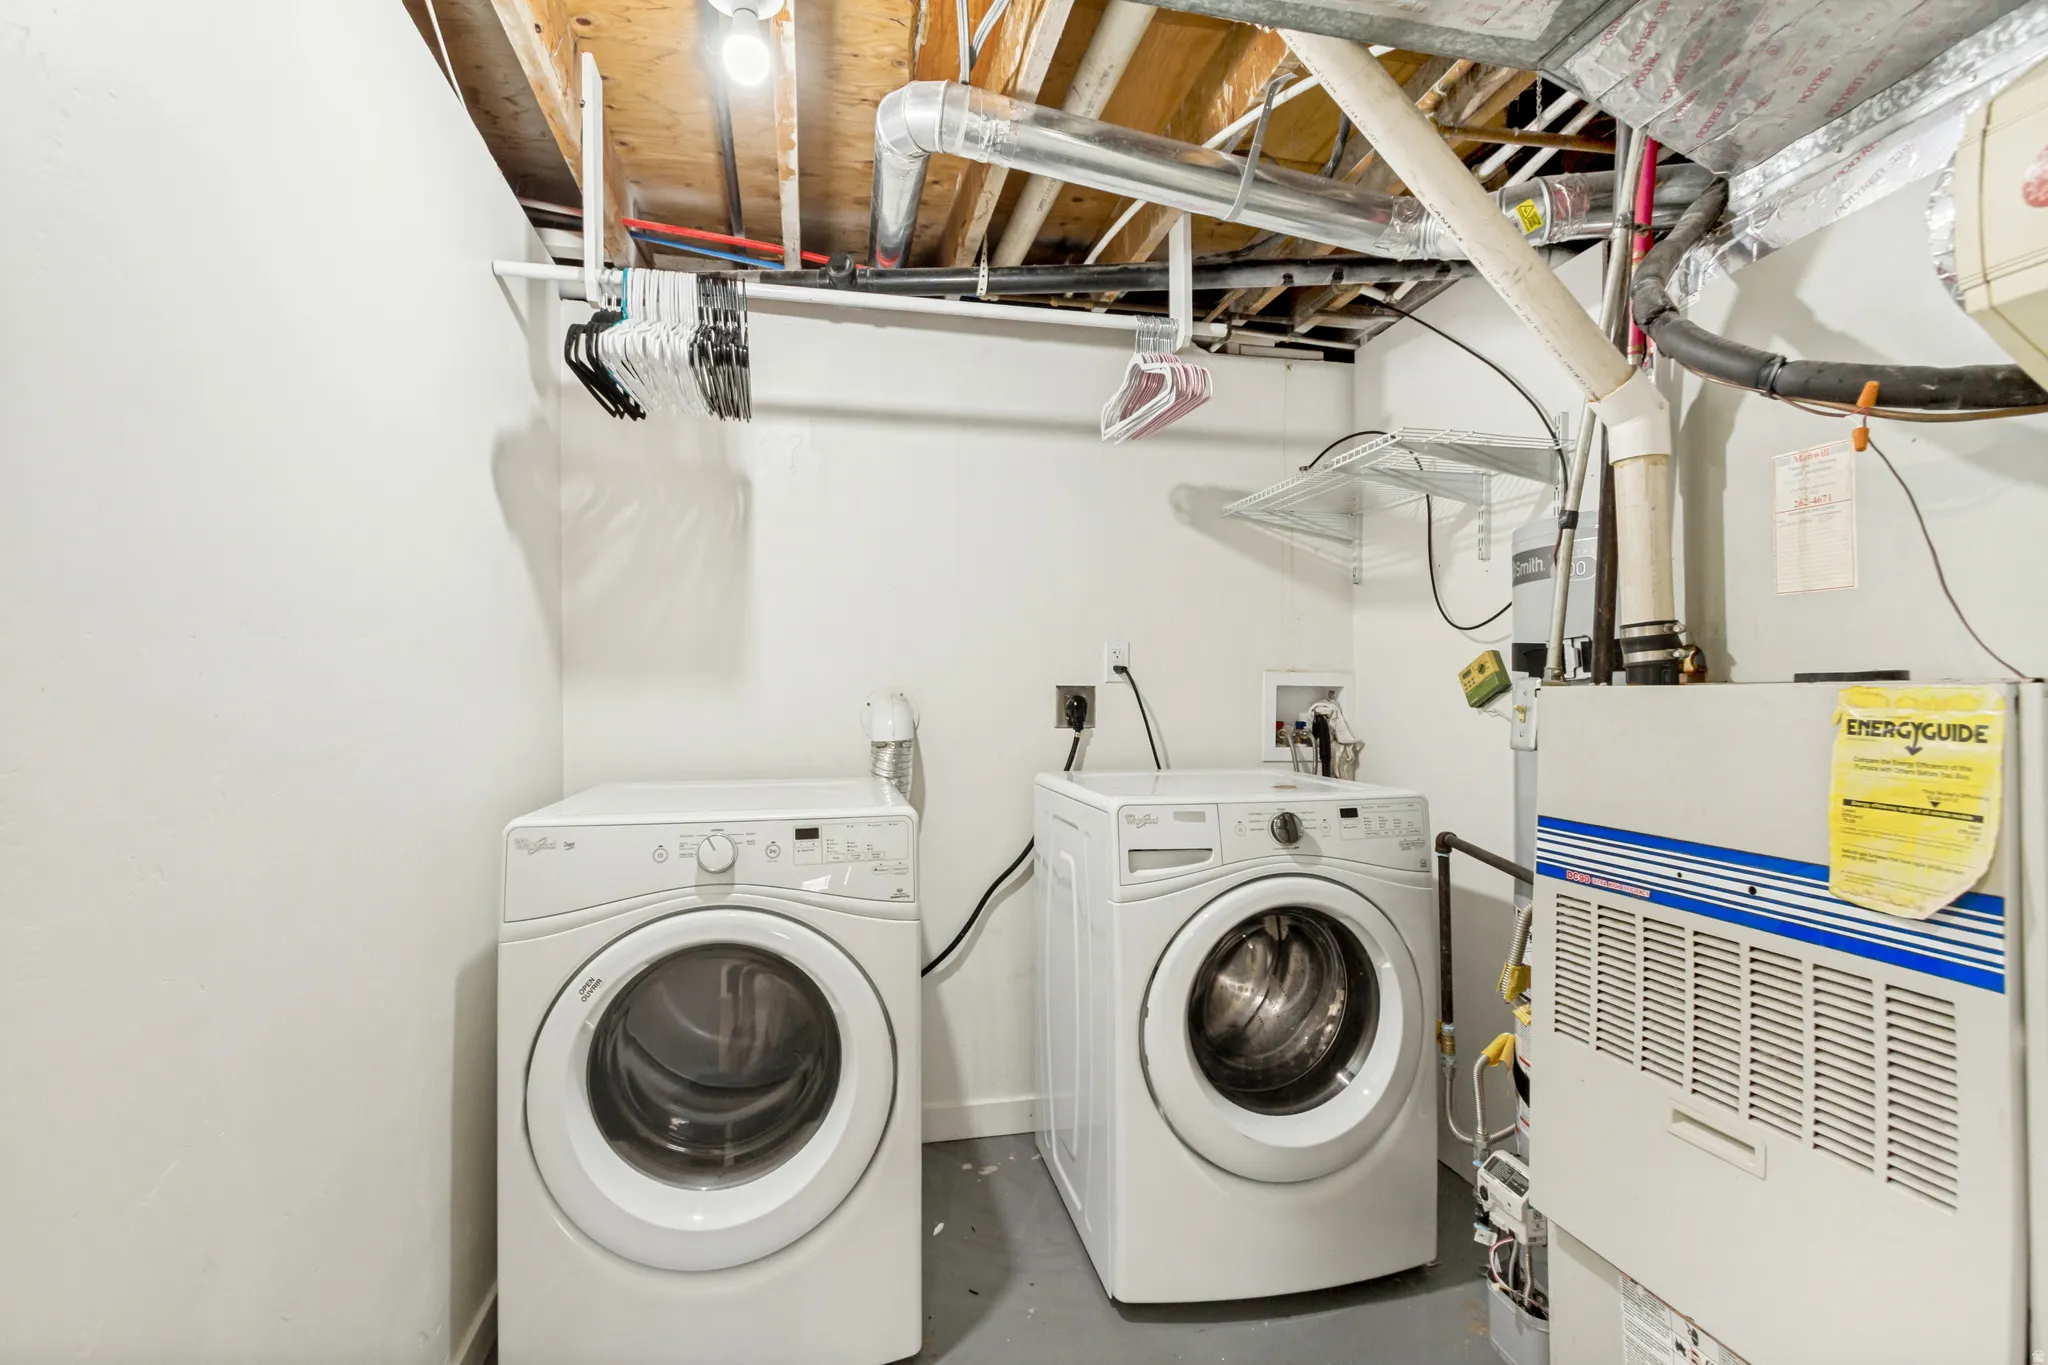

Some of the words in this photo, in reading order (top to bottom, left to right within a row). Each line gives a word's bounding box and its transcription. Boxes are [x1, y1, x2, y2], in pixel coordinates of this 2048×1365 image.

[1628, 20, 1658, 62] POLYKEN
[1794, 493, 1833, 508] 262-4671
[1847, 718, 1989, 745] ENERGYGUIDE
[1125, 814, 1159, 829] Whirlpool
[1566, 869, 1591, 884] DC90
[579, 976, 595, 995] OPEN
[580, 978, 603, 1003] OUVRIR
